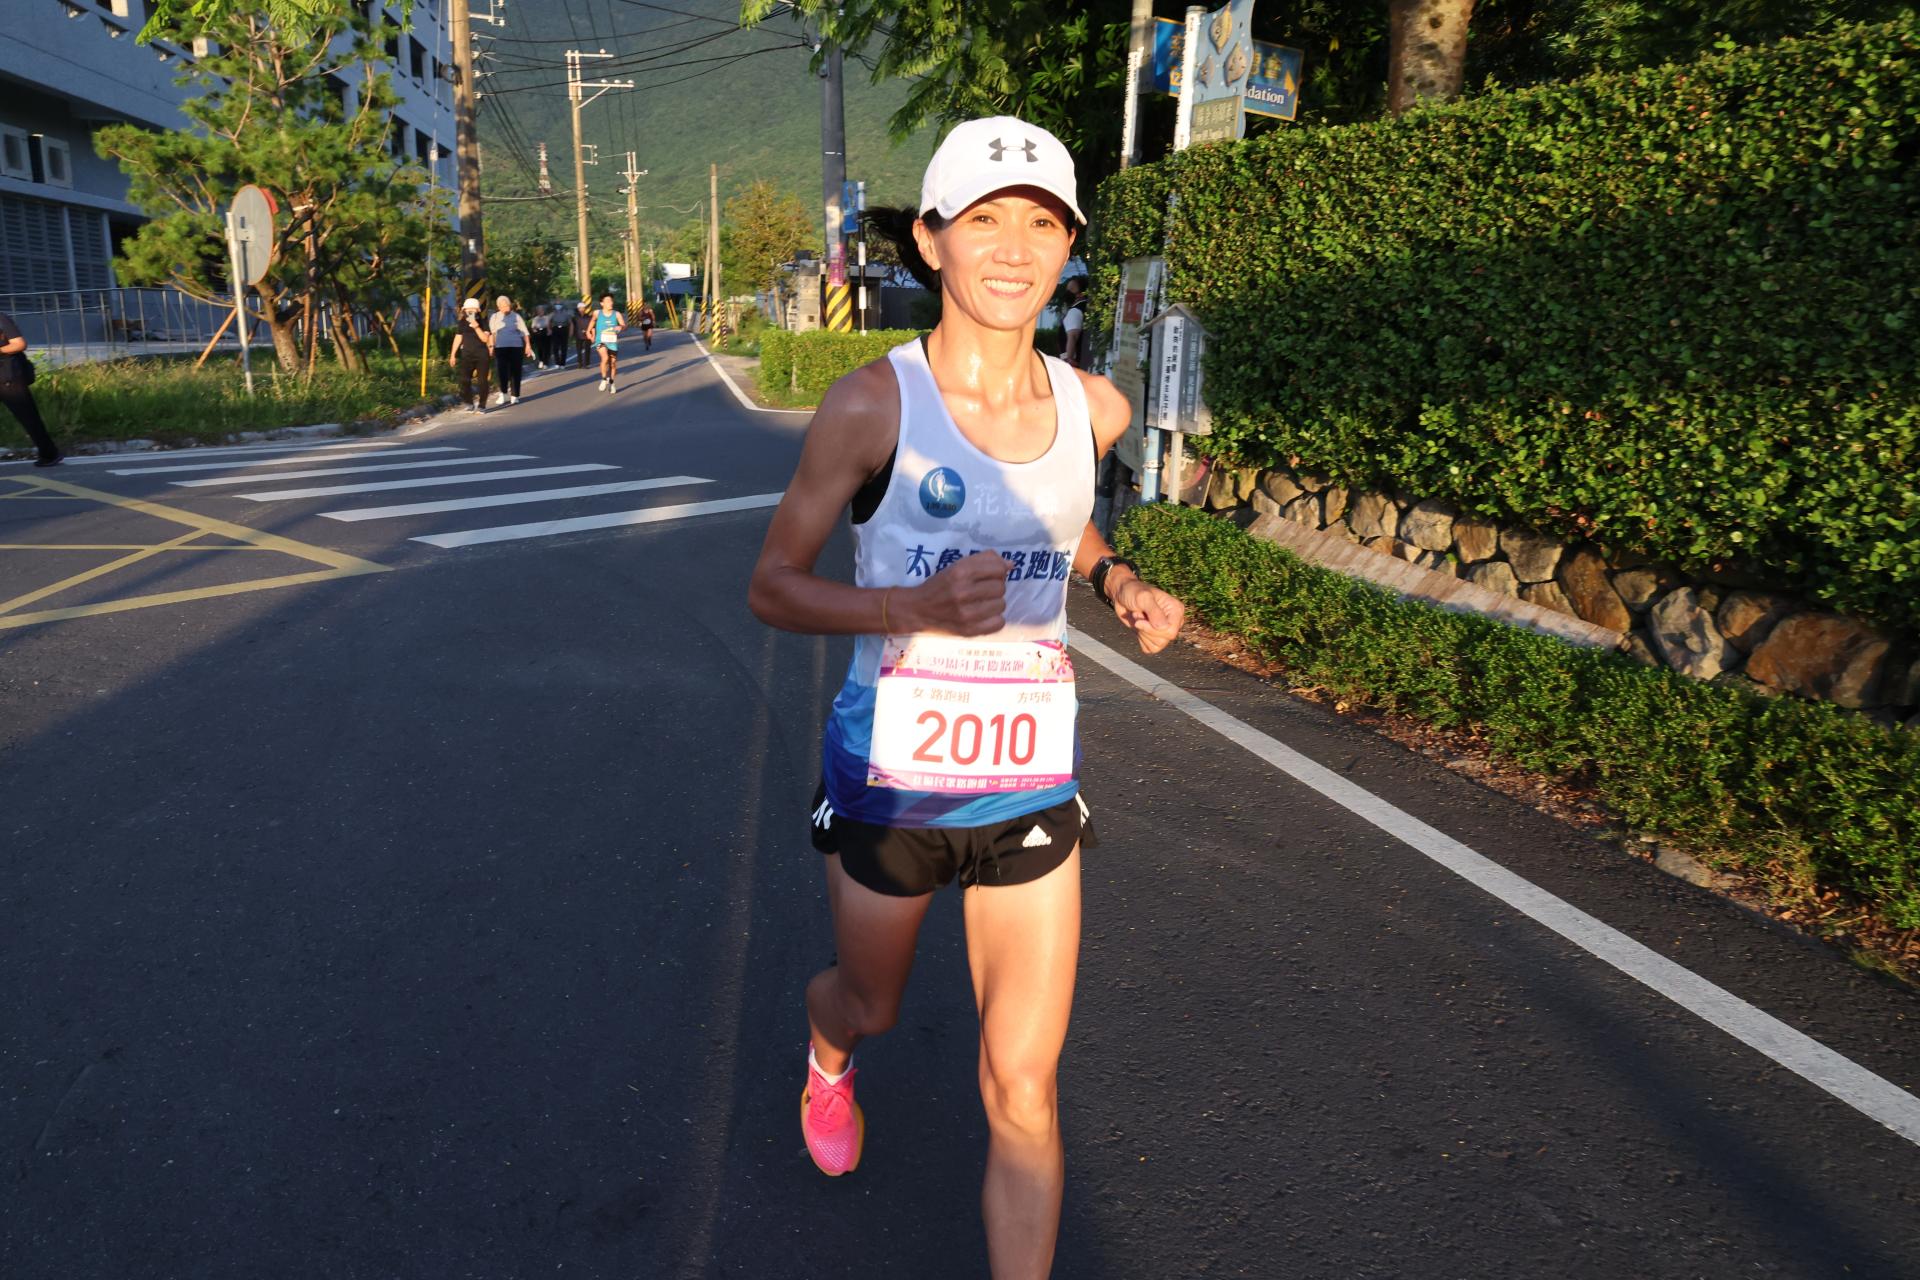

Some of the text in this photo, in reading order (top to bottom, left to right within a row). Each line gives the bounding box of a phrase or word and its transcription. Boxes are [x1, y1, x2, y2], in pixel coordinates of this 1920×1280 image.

[1245, 84, 1285, 105] dation
[906, 545, 1072, 582] 太魯路跑隊
[912, 709, 1037, 766] 2010
